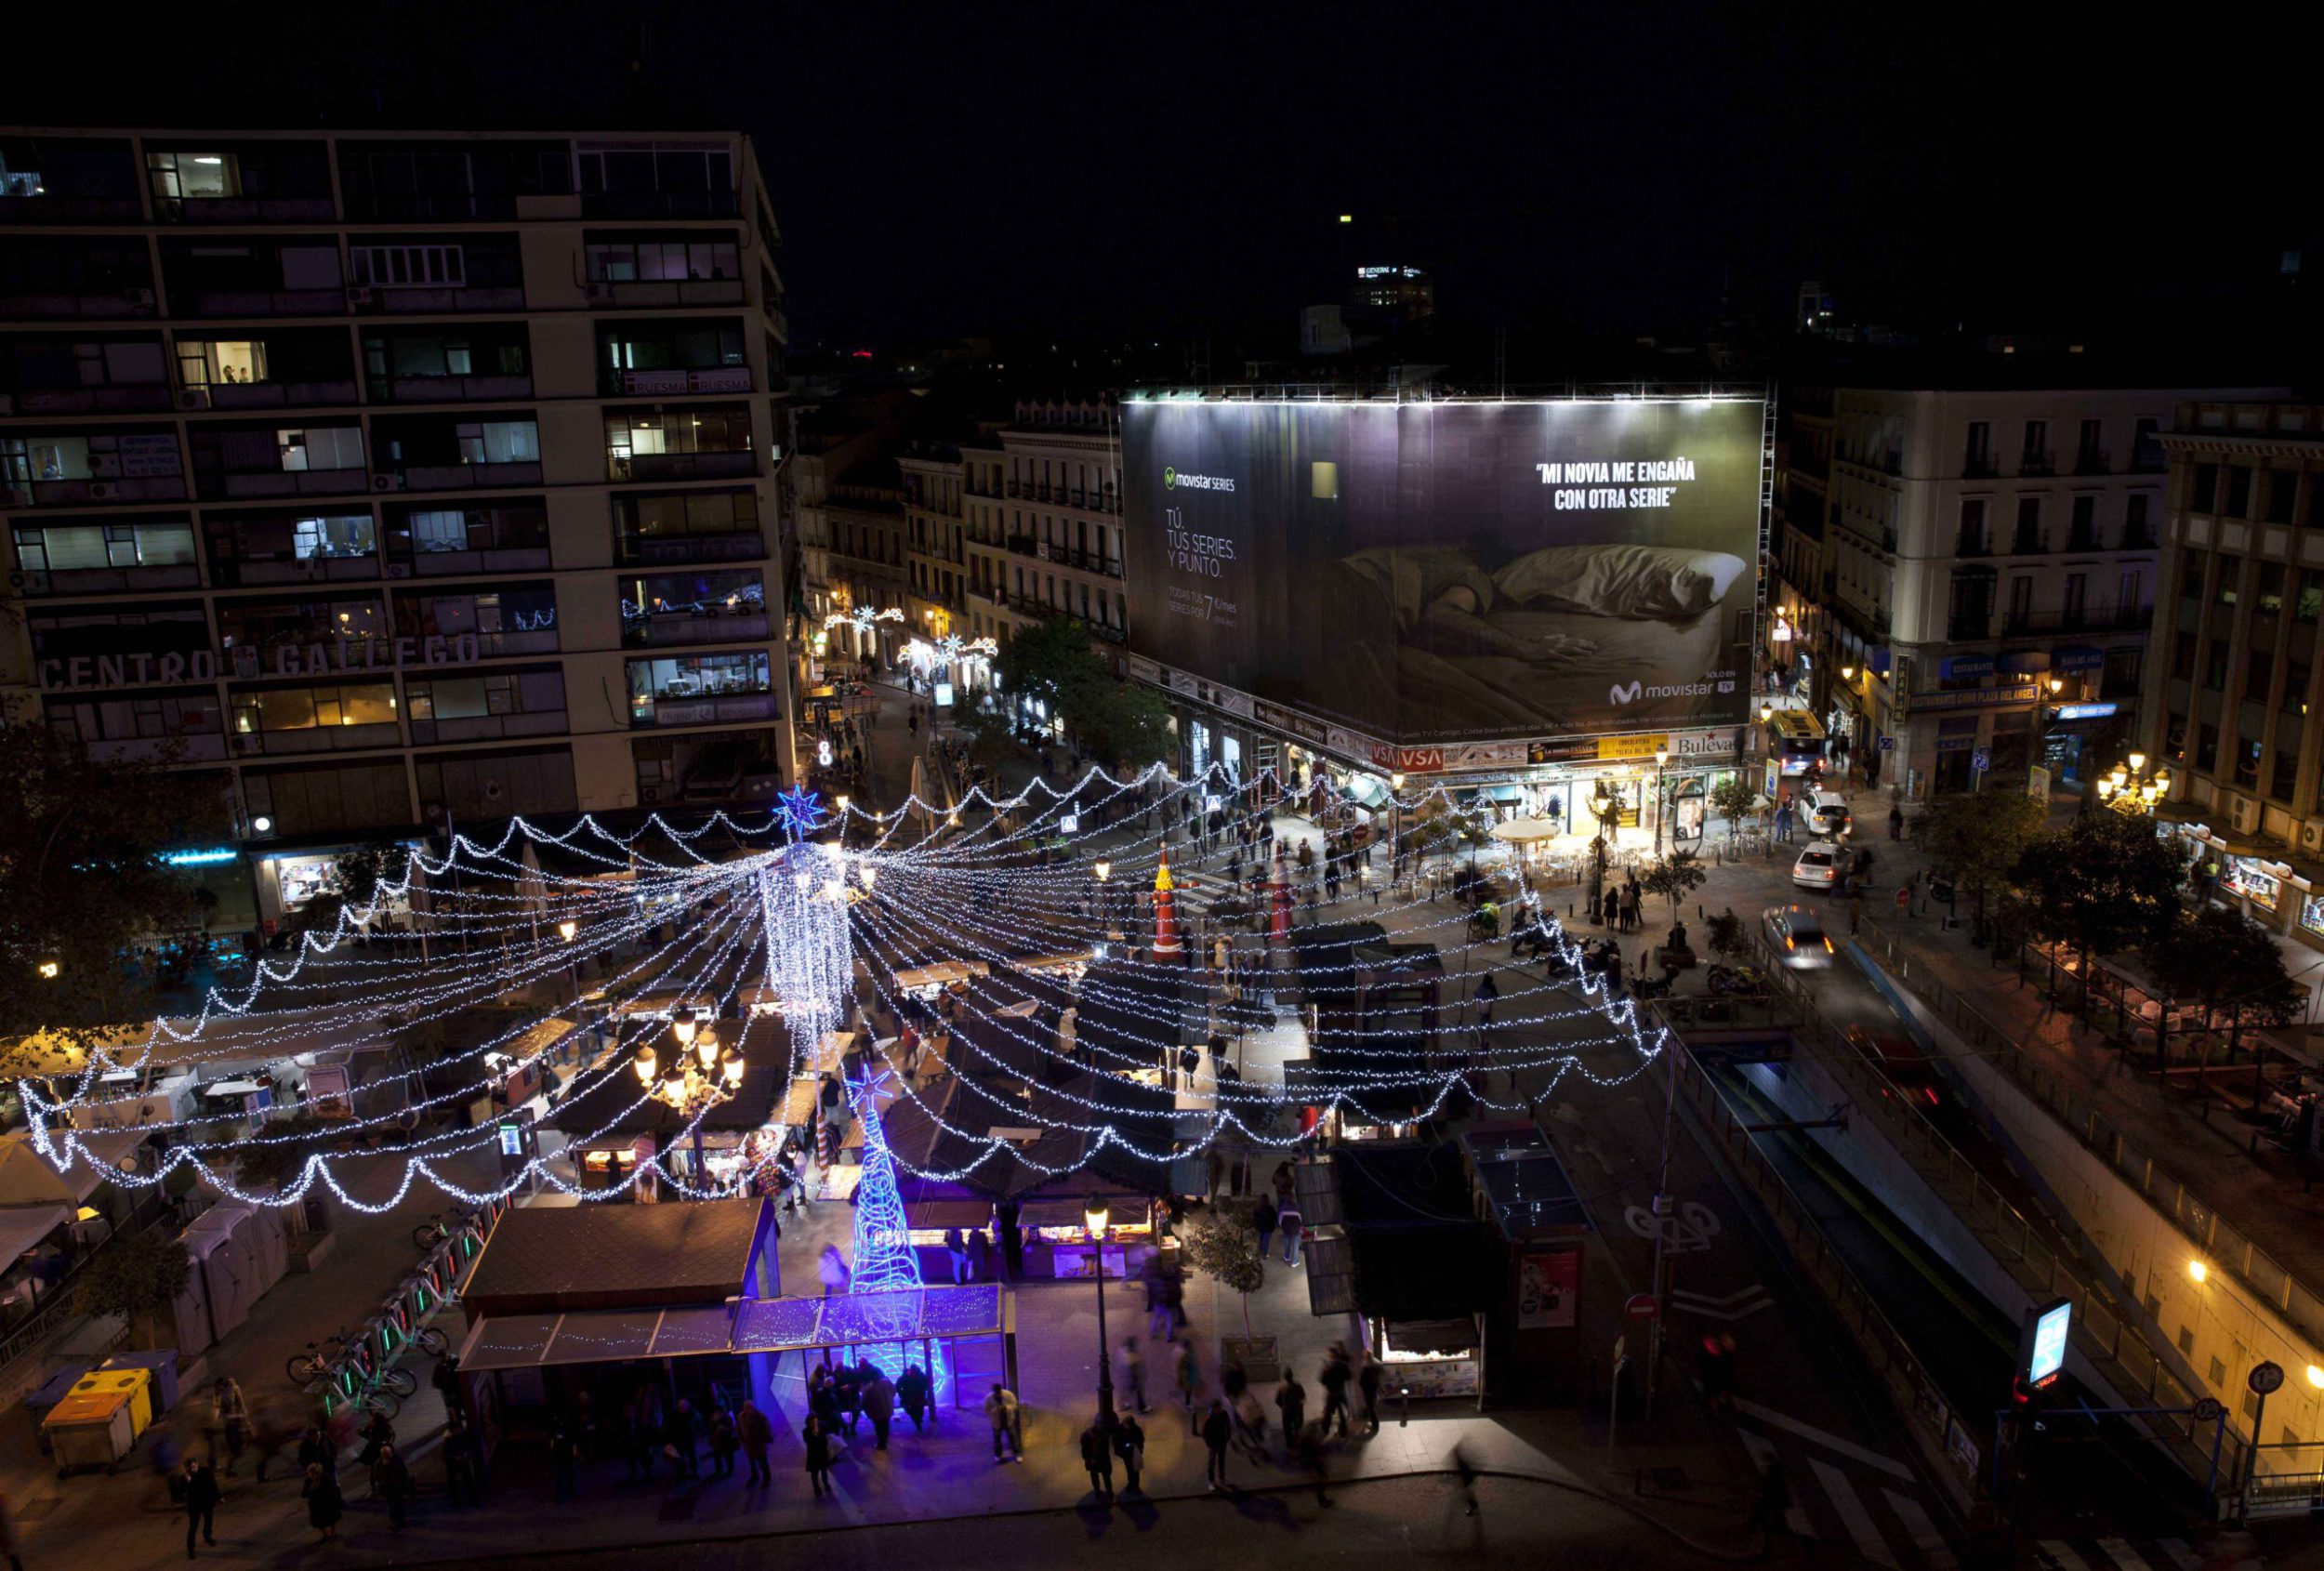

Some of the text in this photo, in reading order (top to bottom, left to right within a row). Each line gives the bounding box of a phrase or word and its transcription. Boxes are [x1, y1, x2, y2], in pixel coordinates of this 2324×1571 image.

[637, 382, 686, 393] RUESMA
[700, 379, 750, 391] RUESMA
[1565, 462, 1609, 483] NOVIA
[1612, 461, 1635, 482] ME
[1638, 456, 1696, 482] ENGAÑA
[1176, 473, 1210, 490] movistar
[1211, 477, 1235, 493] SERIES
[1554, 489, 1586, 510] CON
[1589, 488, 1627, 509] OTRA
[1167, 529, 1190, 551] TUS
[1168, 549, 1176, 568] Y
[1204, 594, 1213, 621] 7
[37, 632, 480, 693] CENTRO GALLEGO
[1645, 682, 1714, 698] movistar
[1978, 690, 2000, 703] PLAZA
[2000, 689, 2013, 702] DEL
